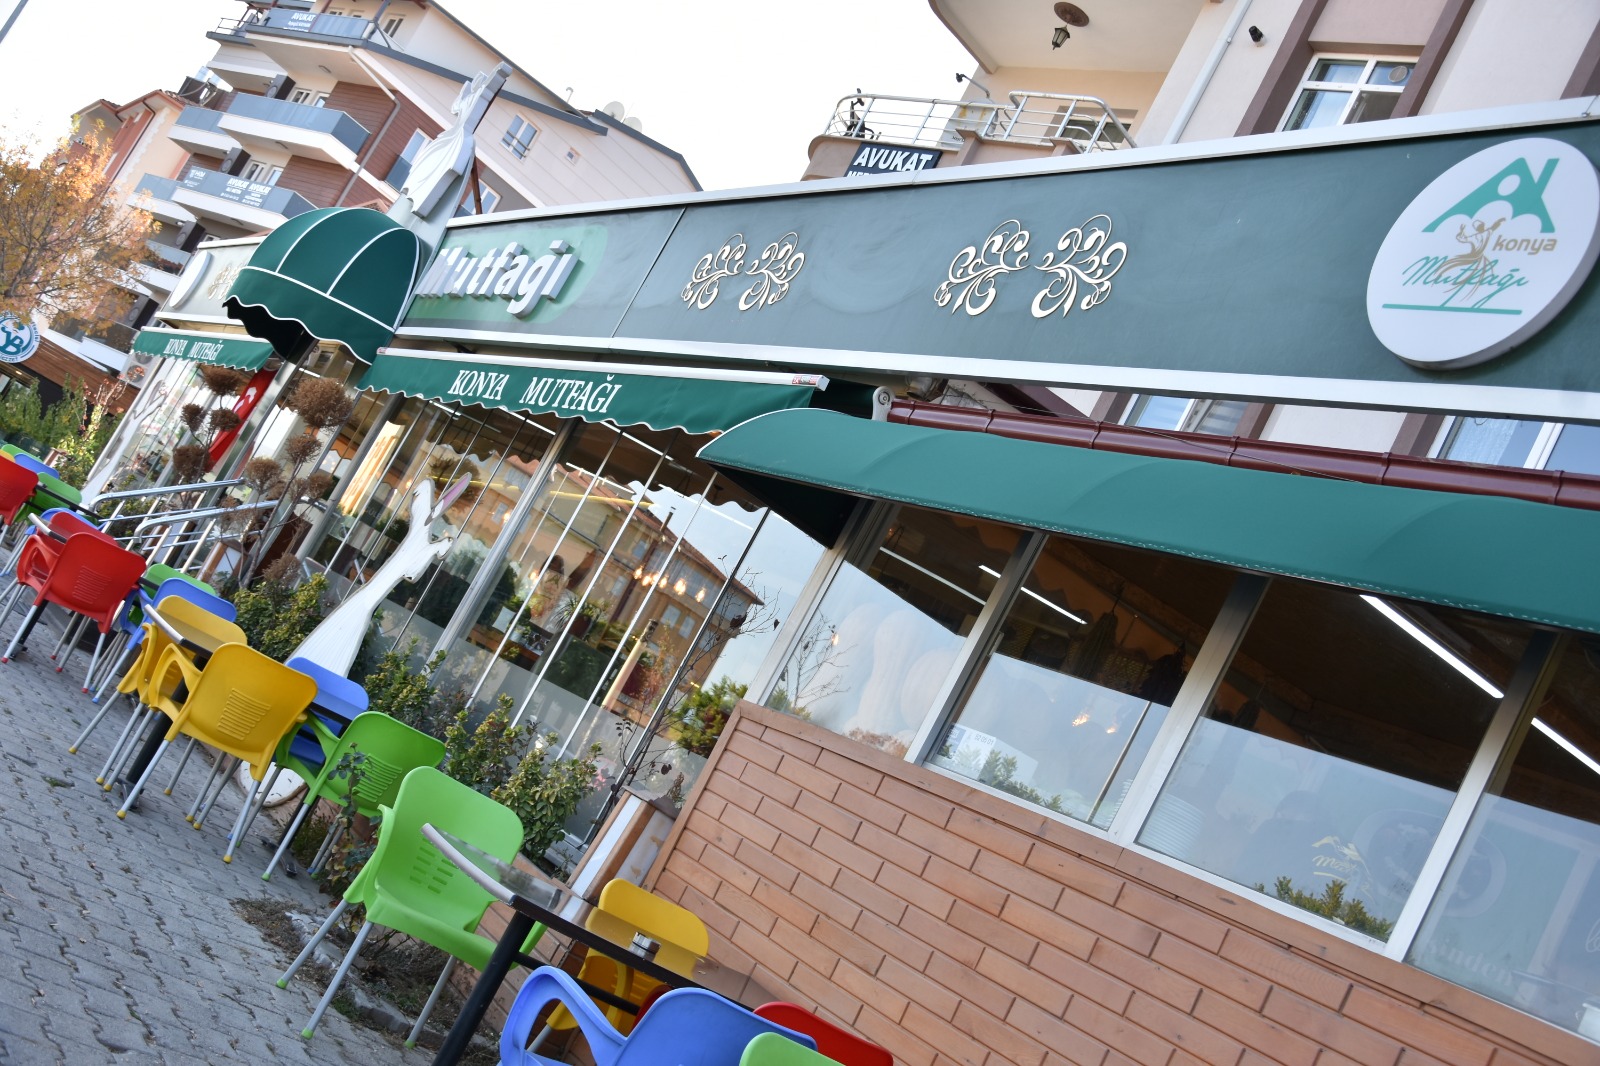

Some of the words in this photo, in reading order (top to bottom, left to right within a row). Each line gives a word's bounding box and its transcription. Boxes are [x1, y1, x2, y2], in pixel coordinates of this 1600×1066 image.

[853, 147, 933, 172] AVUKAT
[1492, 234, 1558, 255] konya
[448, 370, 510, 400] KONYA
[519, 374, 622, 413] MUTFAĞI
